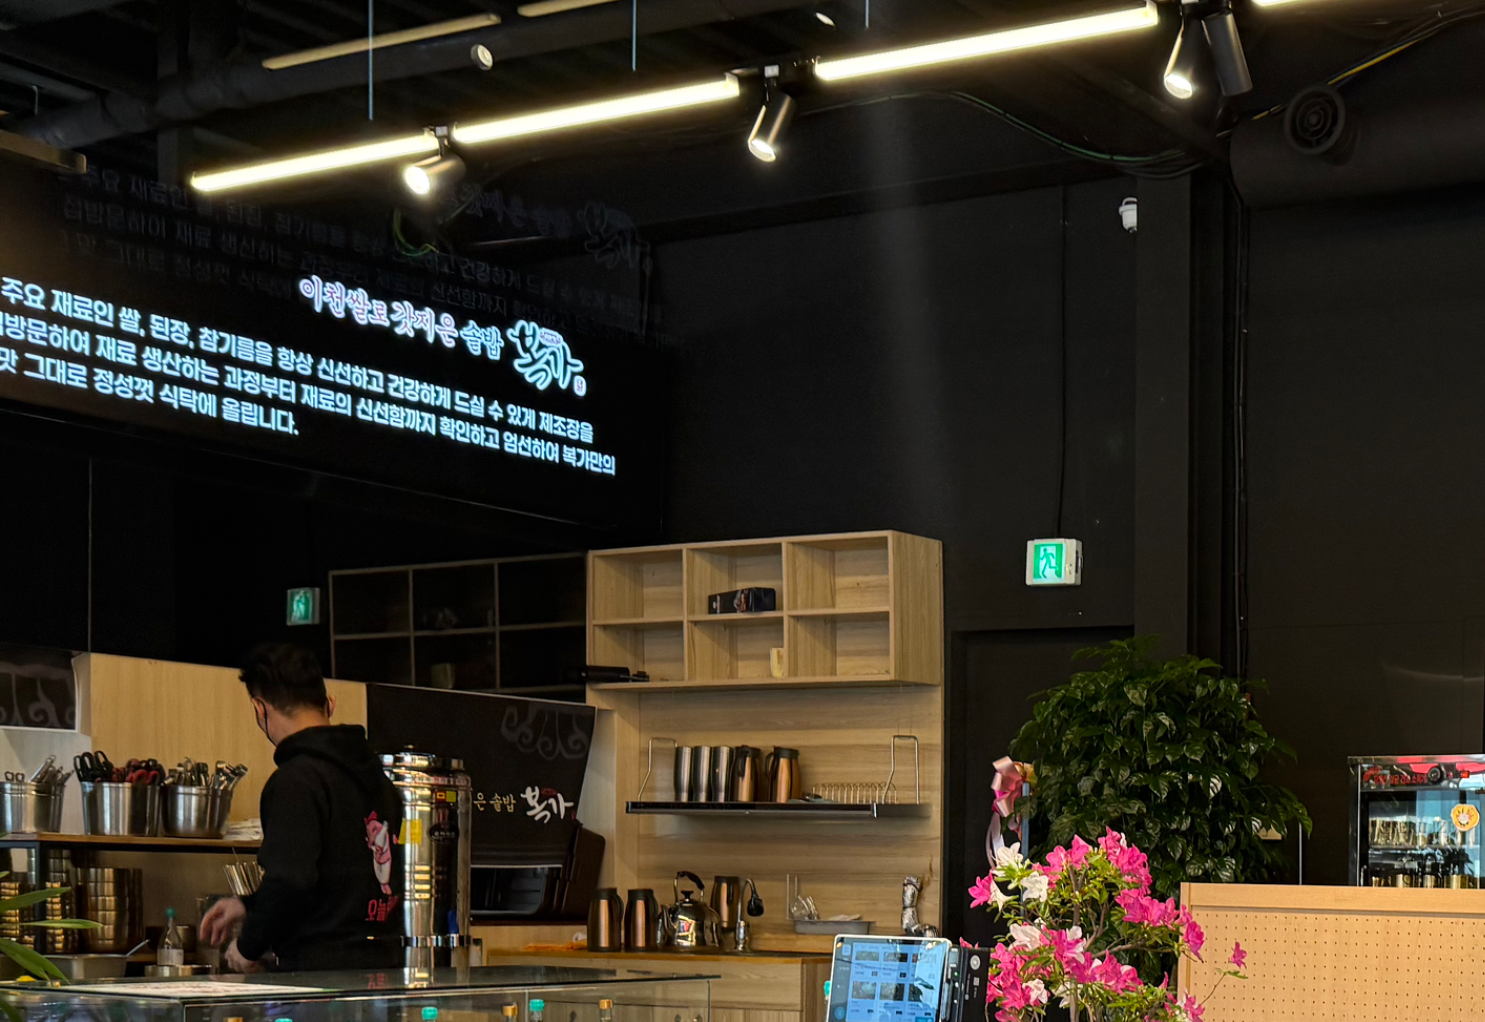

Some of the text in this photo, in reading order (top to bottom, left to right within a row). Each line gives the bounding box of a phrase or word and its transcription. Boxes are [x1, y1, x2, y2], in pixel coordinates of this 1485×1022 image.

[1, 276, 594, 444] 주요 재료인 쌀, 된장, 참기름을 항상 신선하고 건강하게 드실 수 있게 제조장을
[299, 274, 390, 327] 이천쌀로
[390, 300, 458, 348] 갓지은
[506, 319, 584, 390] 복가
[0, 347, 299, 436] 맛 그대로 정성껏 식탁에 올립니다.
[95, 334, 138, 367] 재료
[141, 346, 220, 386] 생산하는
[224, 365, 297, 404] 과정부터
[301, 384, 352, 417] 재료의
[356, 397, 437, 436] 신선함까지
[440, 415, 500, 450] 확인하고
[503, 431, 560, 464] 엄선하여
[563, 444, 616, 476] 복가만의
[520, 785, 575, 824] 복가
